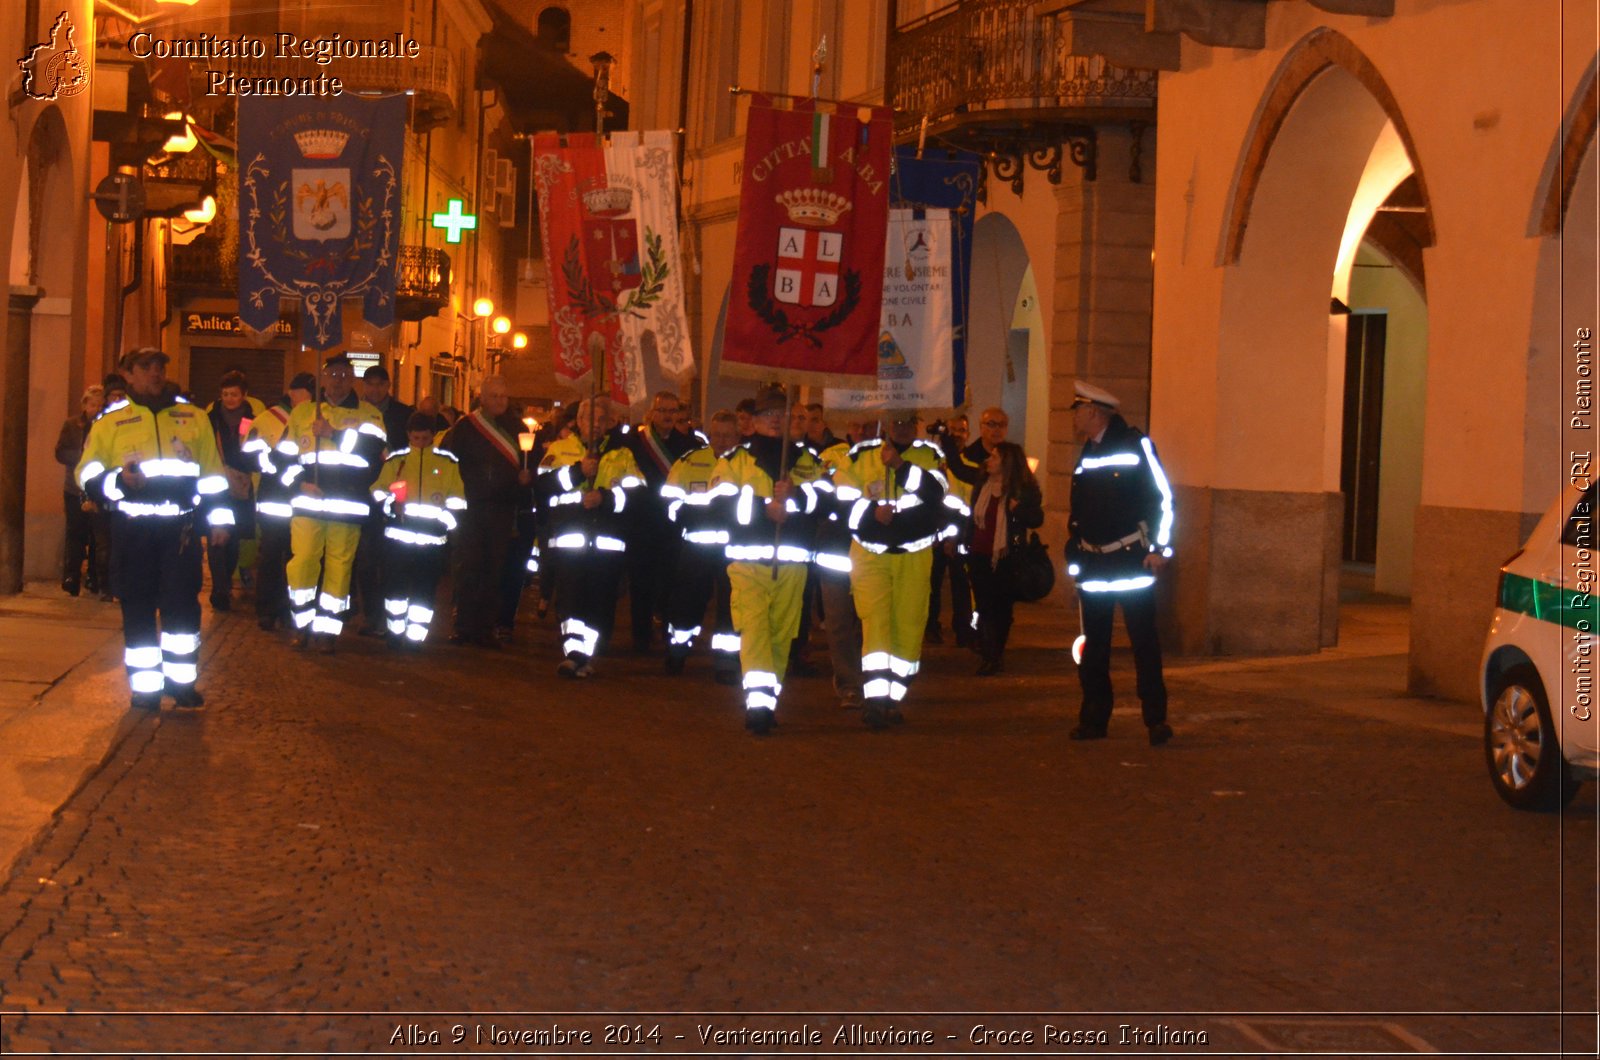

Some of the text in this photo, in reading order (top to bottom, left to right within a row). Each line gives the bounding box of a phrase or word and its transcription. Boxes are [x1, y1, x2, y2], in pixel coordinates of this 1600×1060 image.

[839, 146, 884, 196] ABA
[187, 314, 232, 332] Antica
[888, 312, 912, 327] BA
